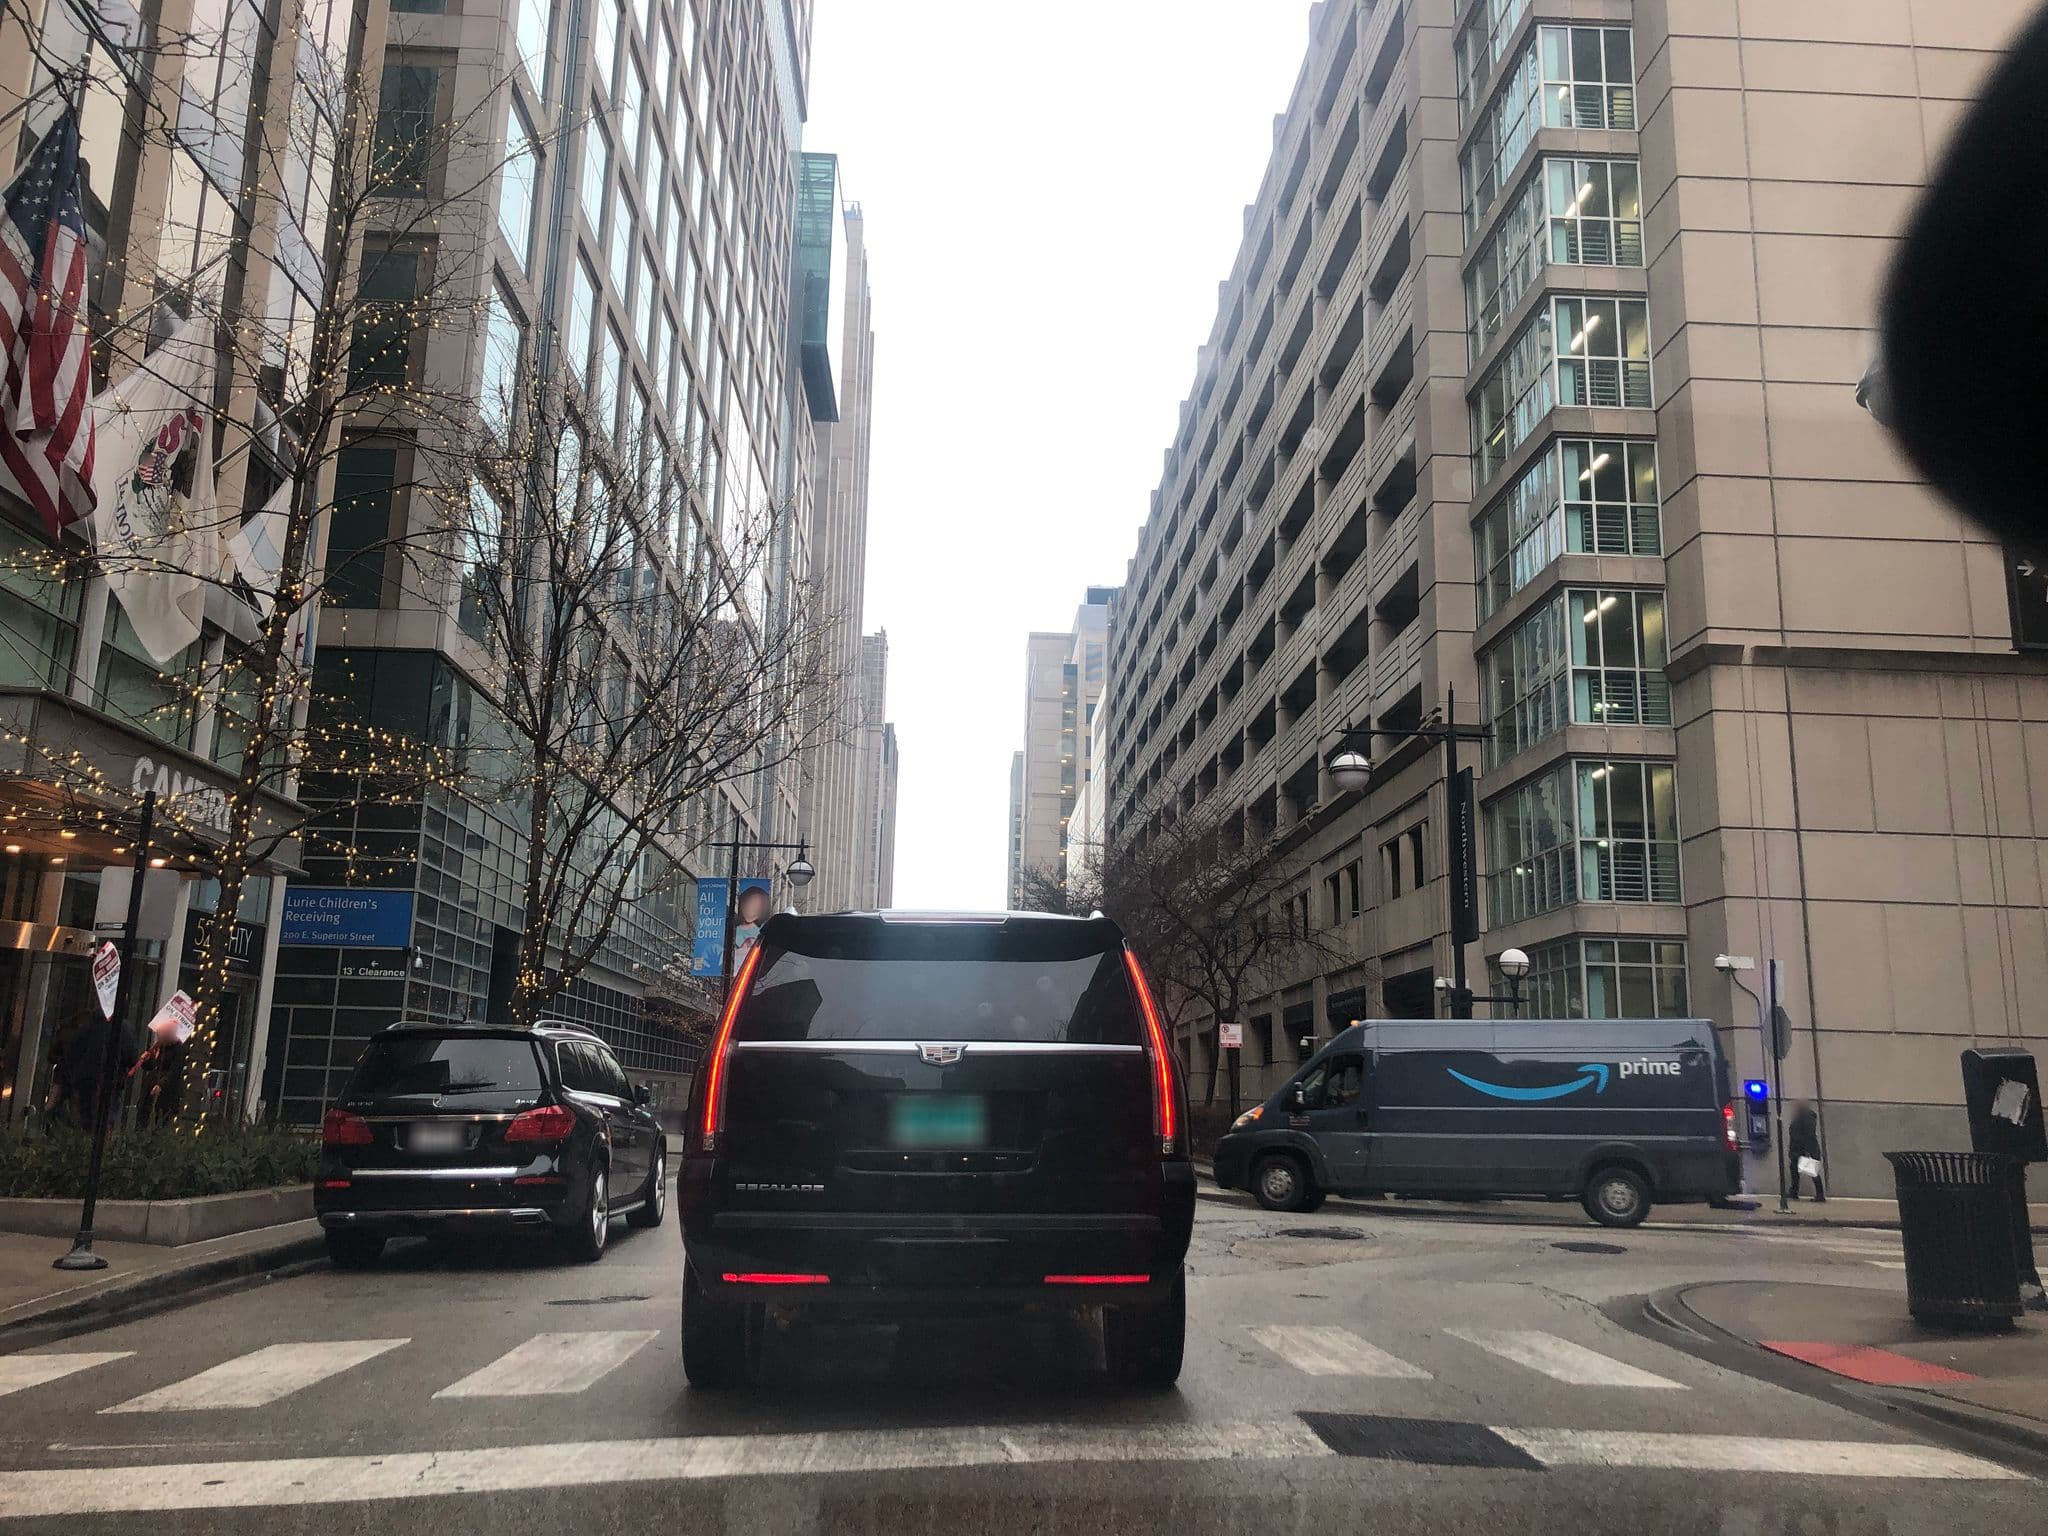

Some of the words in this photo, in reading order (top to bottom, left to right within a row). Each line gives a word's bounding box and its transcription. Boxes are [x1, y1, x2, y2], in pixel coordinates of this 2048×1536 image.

[287, 897, 317, 908] Lurie
[319, 897, 378, 910] Children's
[700, 905, 716, 916] for
[285, 910, 341, 926] Receiving
[699, 917, 725, 929] your
[302, 931, 310, 939] E.
[312, 931, 348, 942] Superior
[349, 932, 375, 941] Street
[342, 967, 356, 976] 13'
[358, 967, 405, 977] Clearance
[1619, 1057, 1681, 1079] prime
[735, 1183, 825, 1191] ESCALADE
